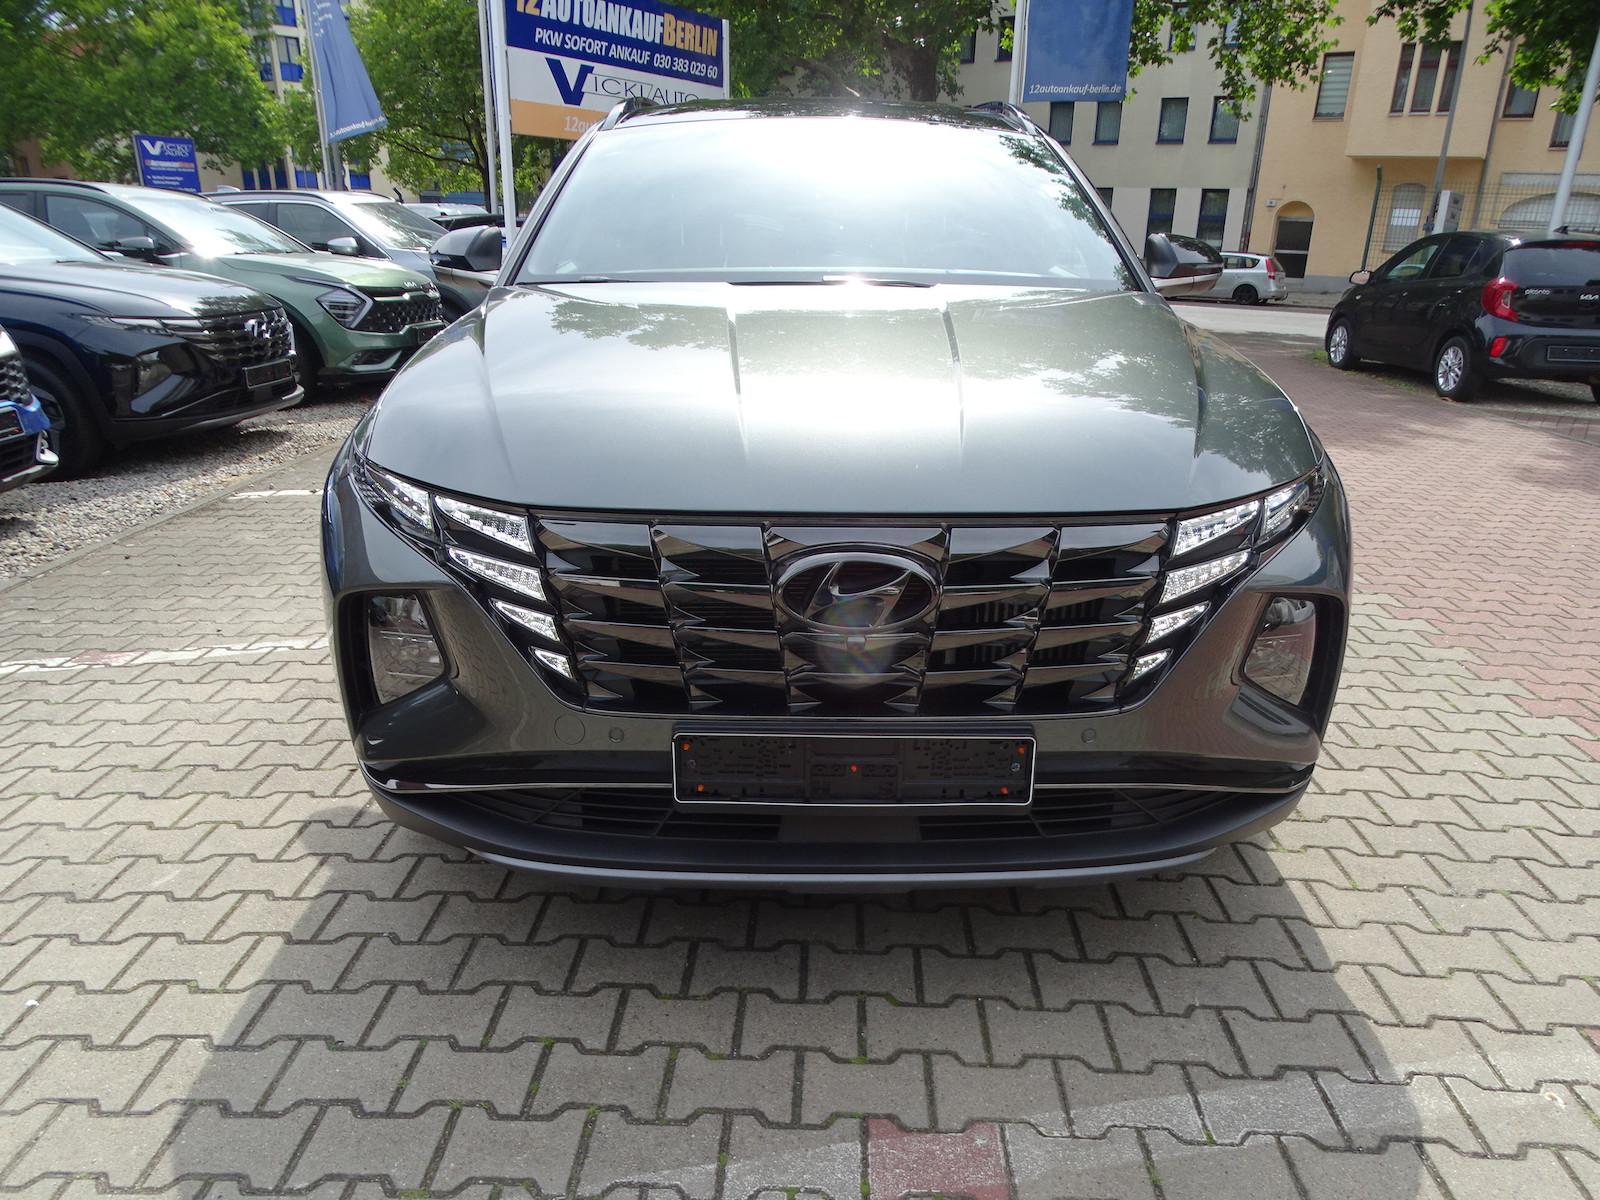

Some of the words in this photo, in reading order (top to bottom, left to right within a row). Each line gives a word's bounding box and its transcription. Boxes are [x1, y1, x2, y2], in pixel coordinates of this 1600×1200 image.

[535, 27, 563, 47] PKW
[564, 33, 608, 56] SOFORT
[609, 43, 651, 65] ANKAUF
[653, 53, 671, 69] 030
[672, 57, 689, 73] 383
[690, 61, 706, 77] 029
[707, 65, 718, 79] 60
